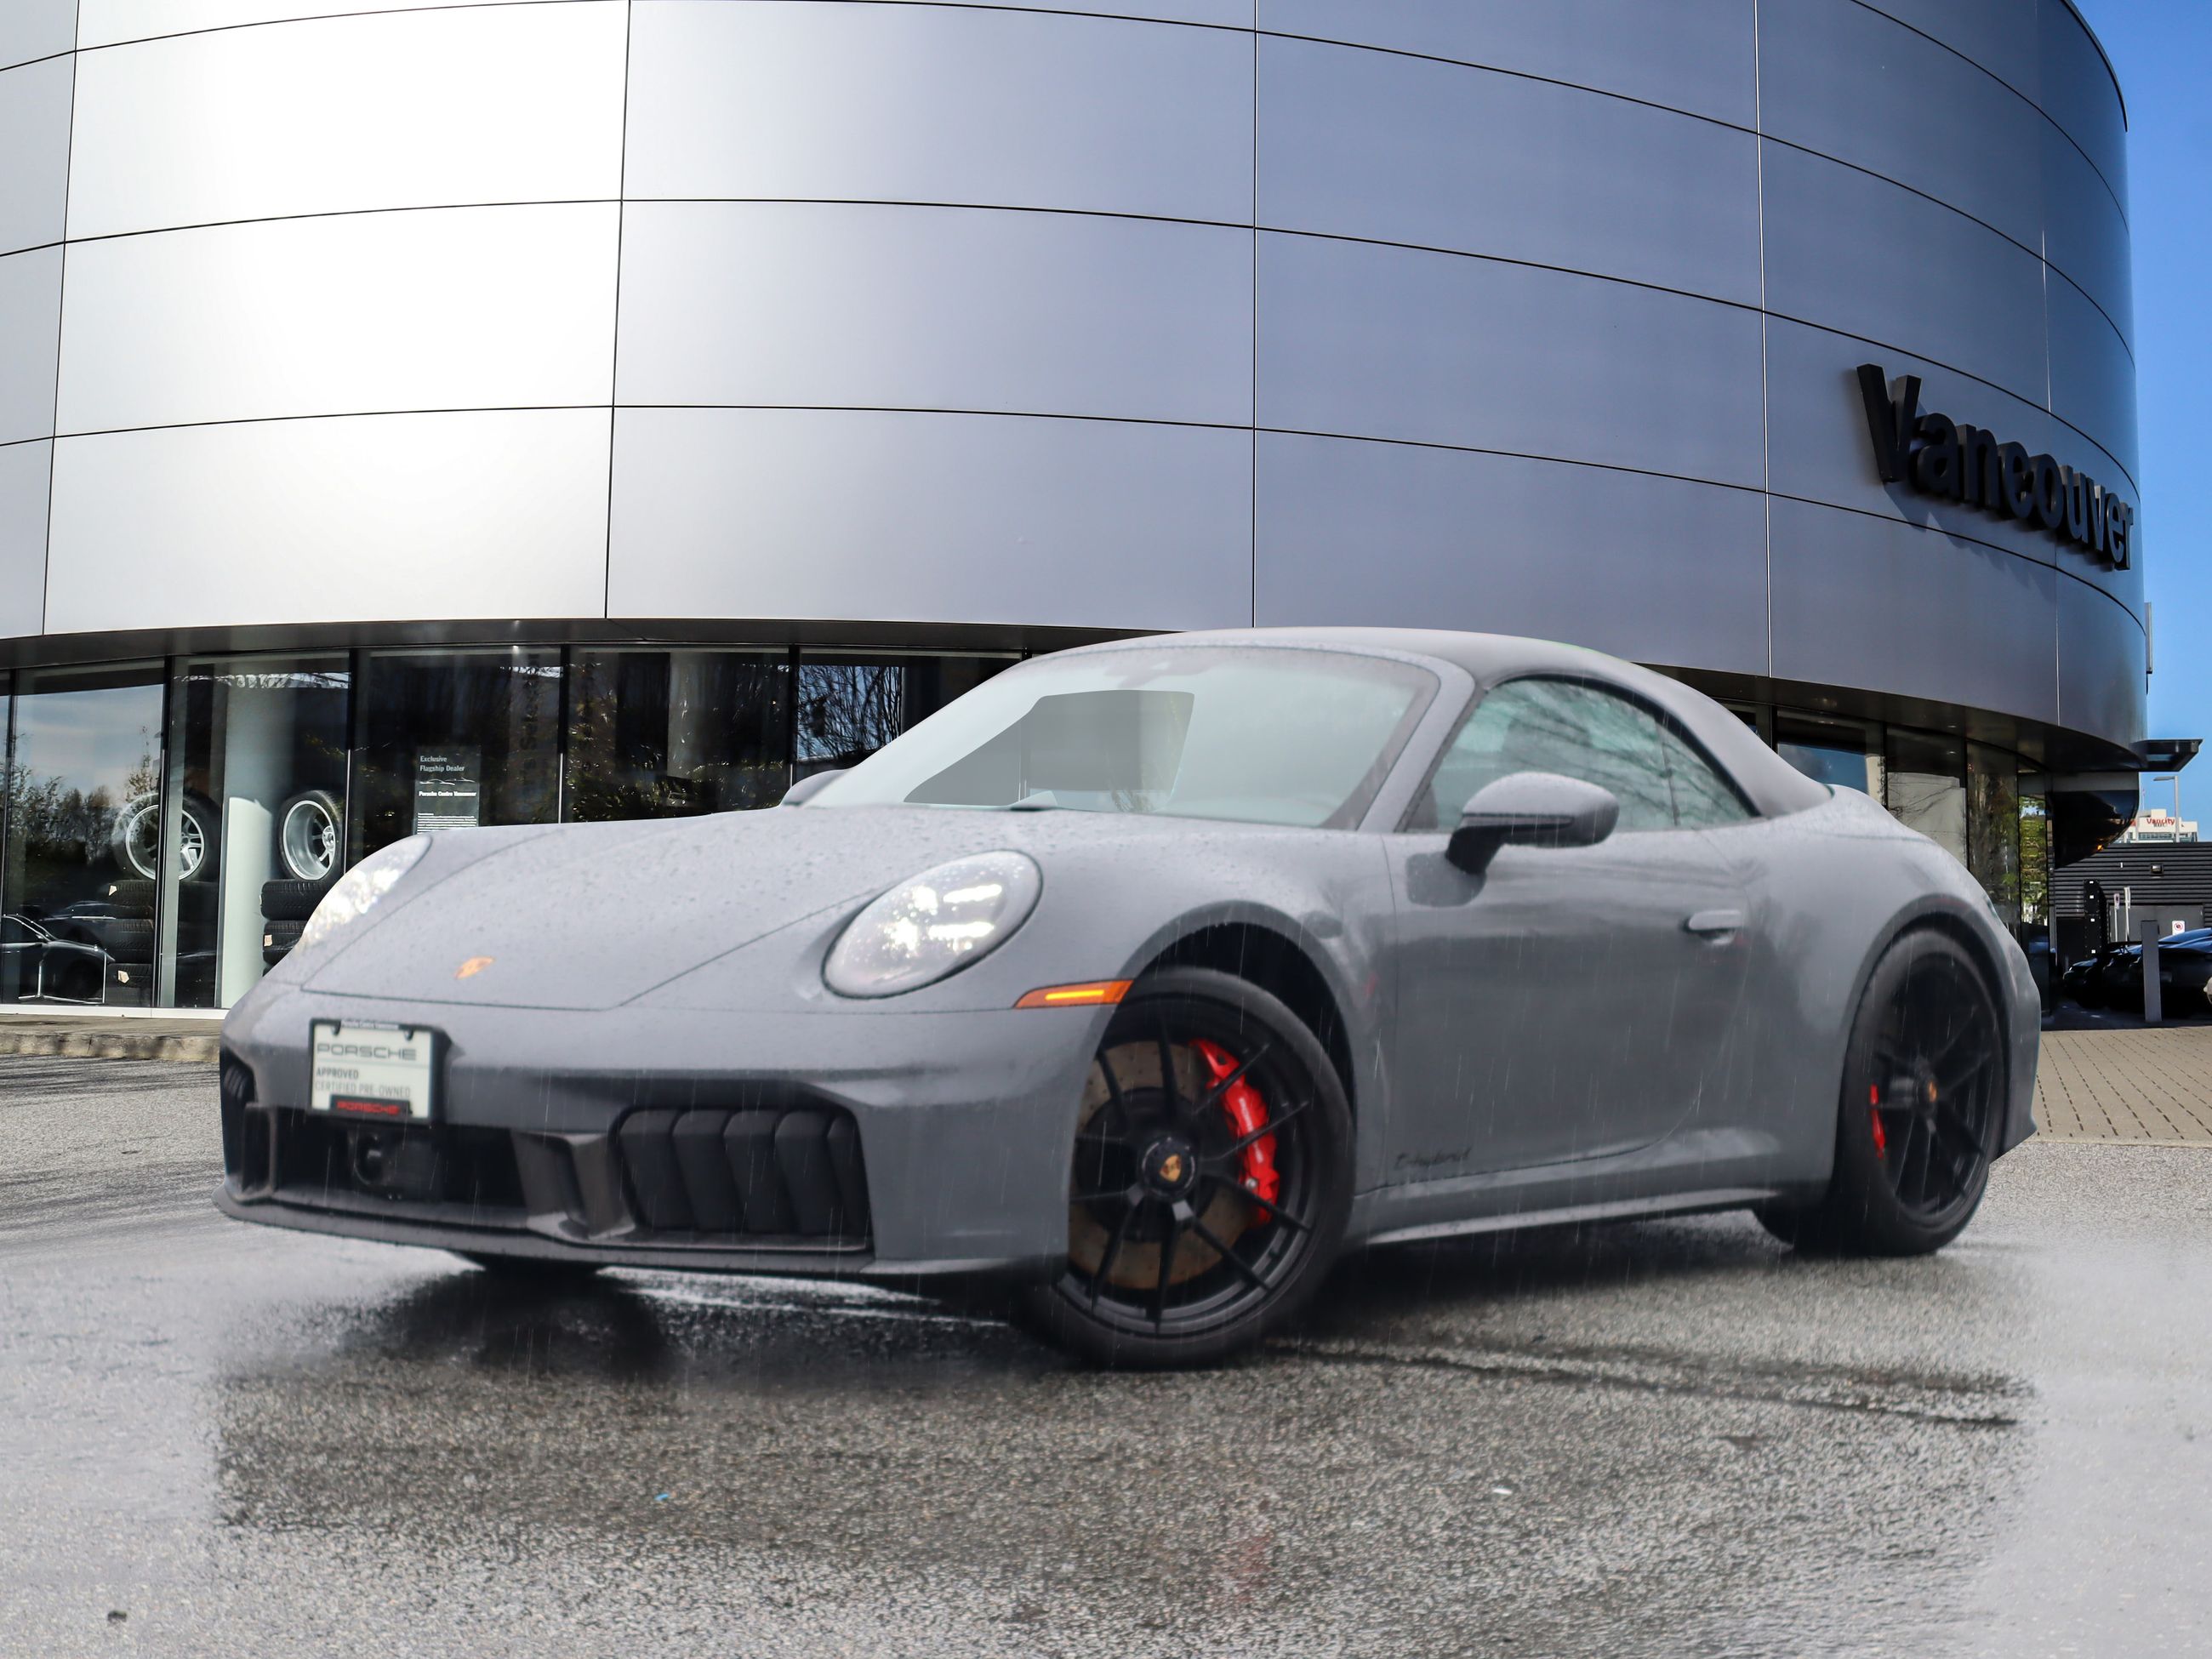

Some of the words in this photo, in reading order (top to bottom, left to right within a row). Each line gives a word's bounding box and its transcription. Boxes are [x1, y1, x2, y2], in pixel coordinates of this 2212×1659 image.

[1856, 363, 2134, 571] Vancouver
[2146, 817, 2175, 825] Vancity
[316, 1043, 417, 1061] PORSCHE
[316, 1068, 360, 1079] APPROVED
[315, 1081, 356, 1092] CERTIFIED
[336, 1100, 401, 1115] PORSCHE
